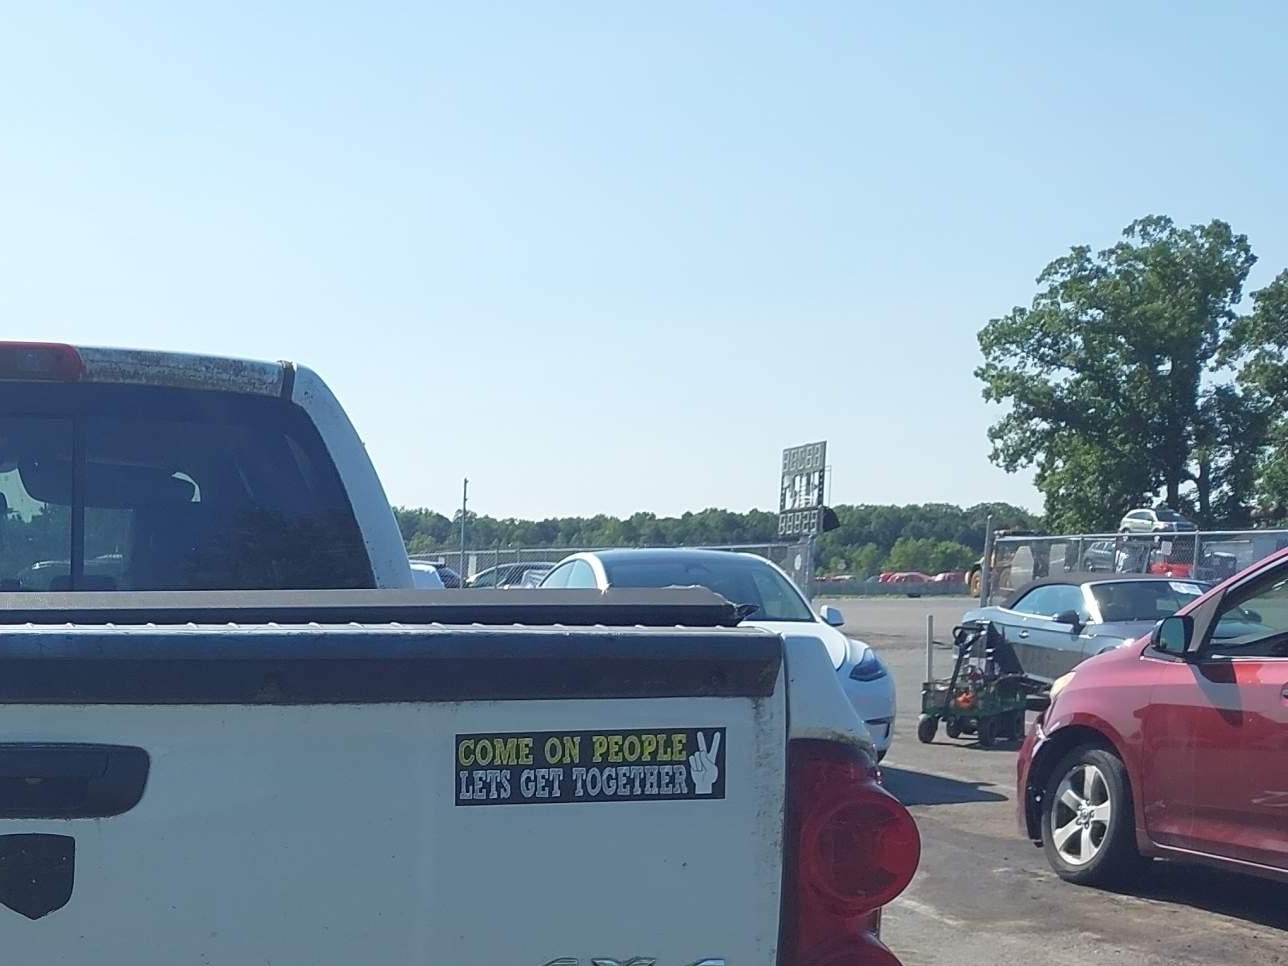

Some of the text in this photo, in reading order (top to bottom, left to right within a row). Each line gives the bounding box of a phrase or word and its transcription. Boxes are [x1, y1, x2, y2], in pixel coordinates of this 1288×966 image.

[458, 733, 687, 766] COME ON PEOPLE
[459, 765, 688, 799] LETS GET TOGETHER
